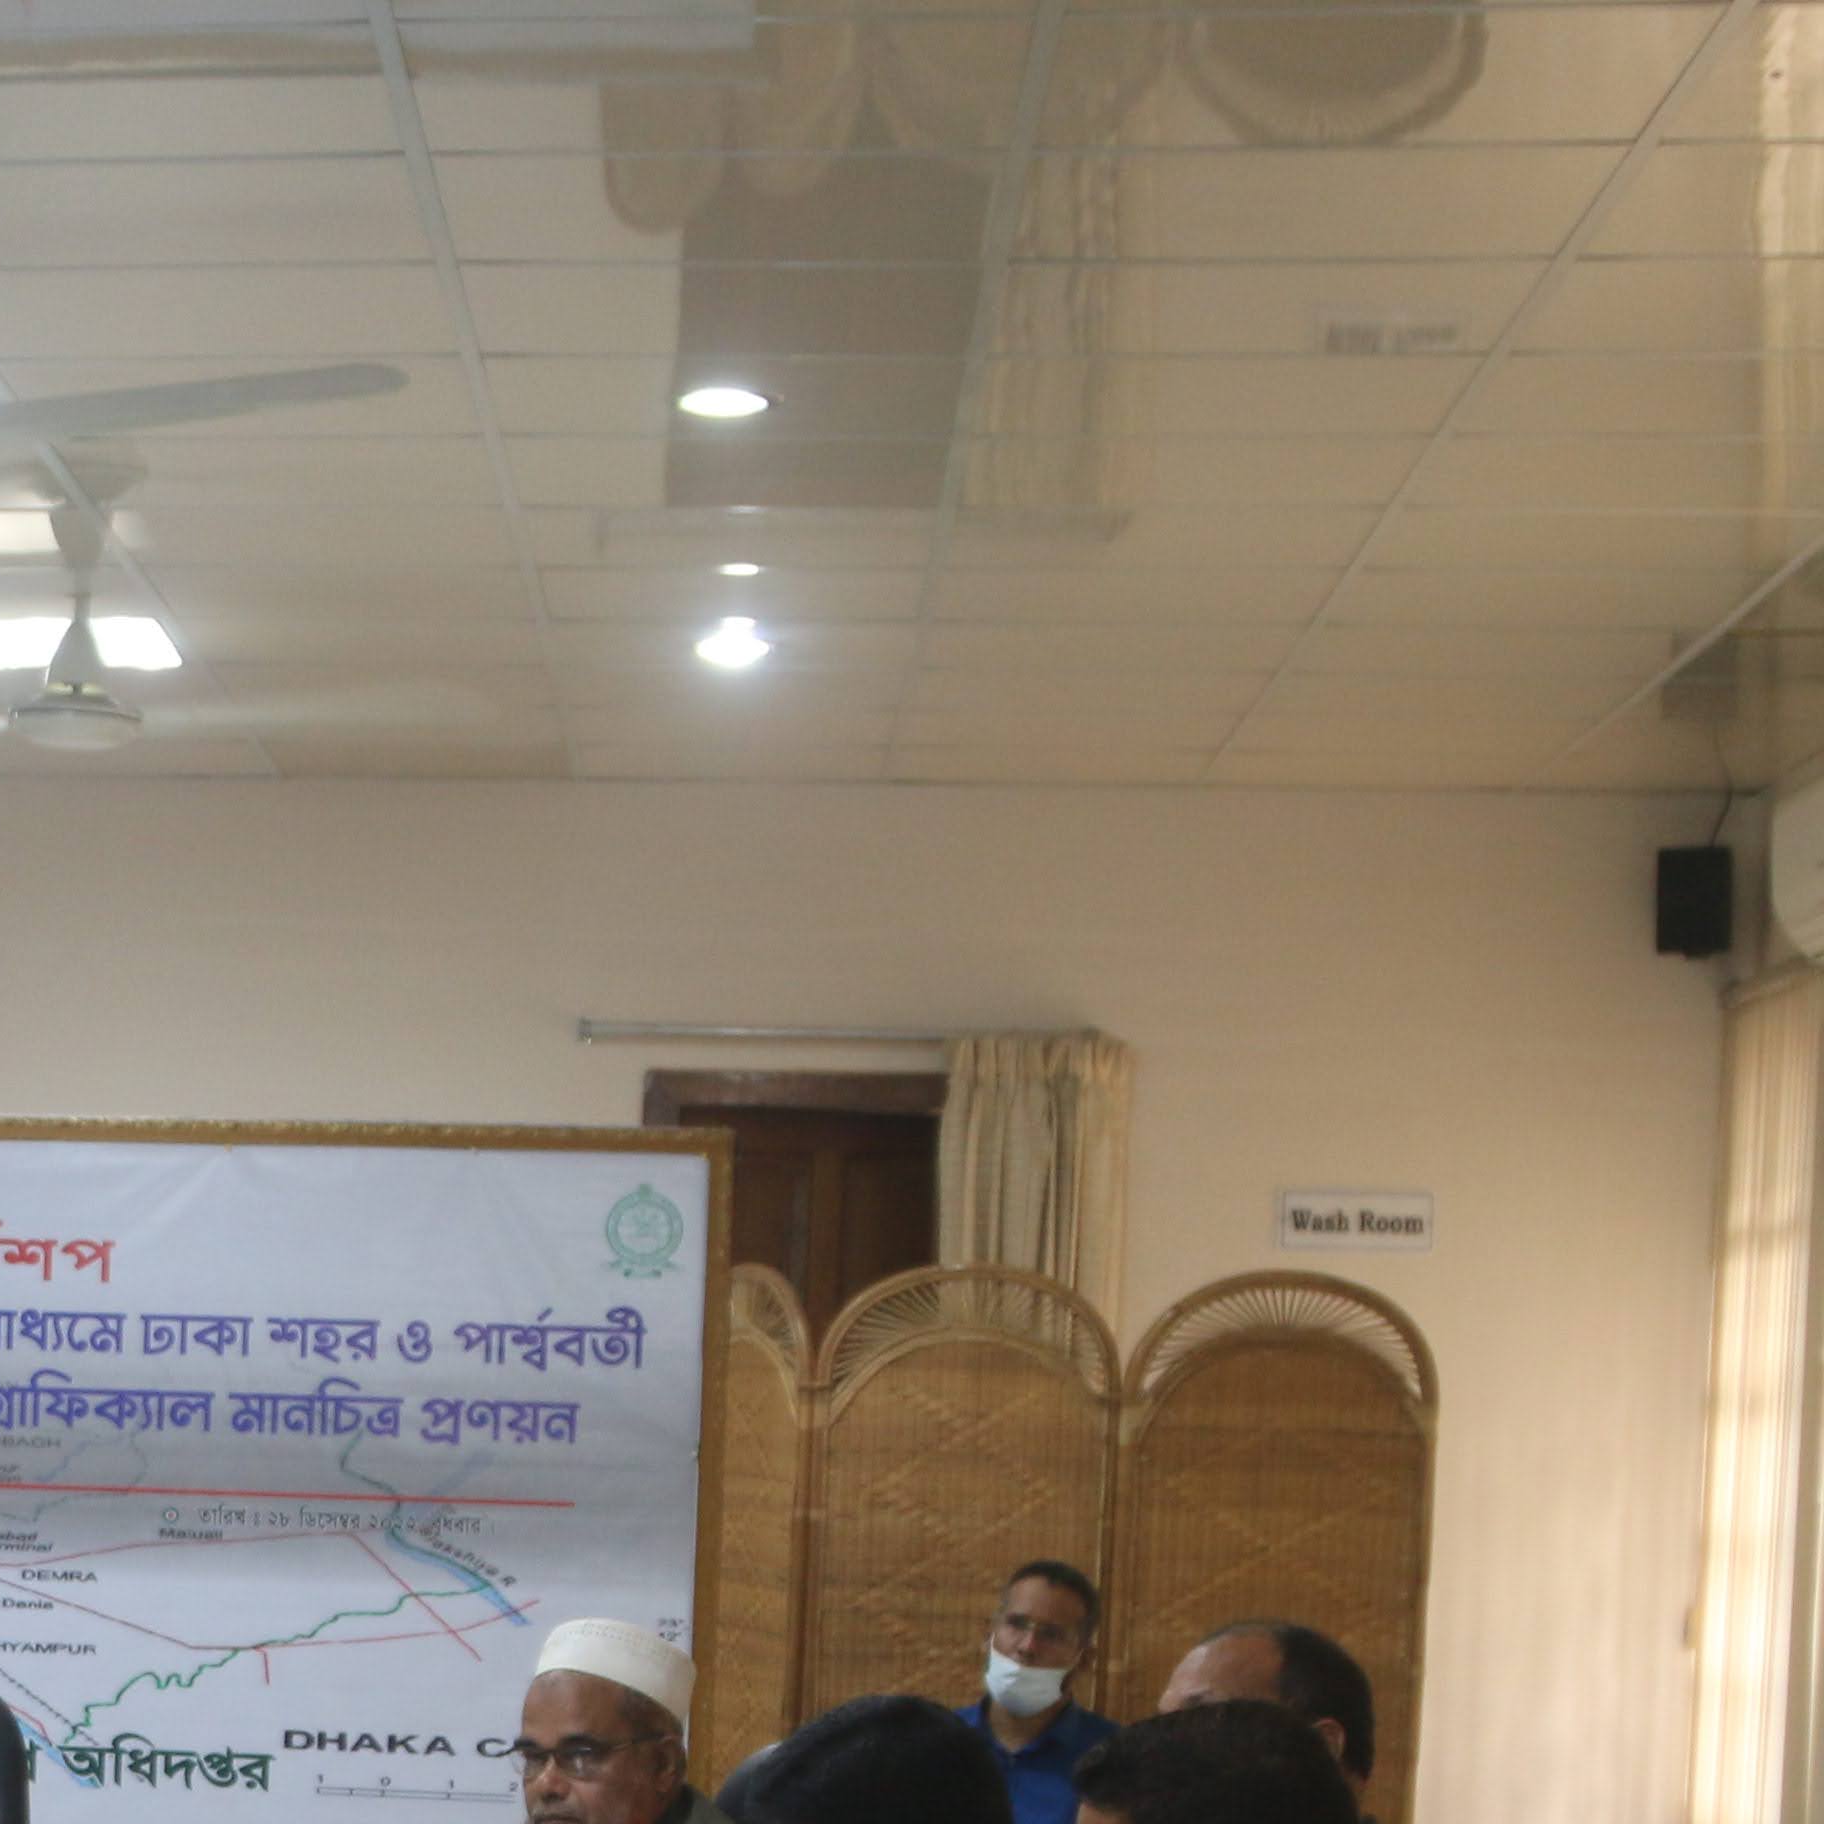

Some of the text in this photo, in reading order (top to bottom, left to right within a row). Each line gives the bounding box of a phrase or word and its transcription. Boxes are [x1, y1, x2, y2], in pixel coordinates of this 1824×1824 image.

[1291, 1208, 1425, 1234] Wash Room
[141, 1312, 252, 1358] ঢাকা
[268, 1318, 381, 1363] শহর
[397, 1322, 433, 1364] ও
[230, 1376, 405, 1439] মানচিত্র
[420, 1398, 580, 1446] প্রণয়ন
[21, 1569, 98, 1583] DEMRA
[283, 1729, 456, 1756] DHAKA
[56, 1733, 276, 1793] অধিদপ্তর
